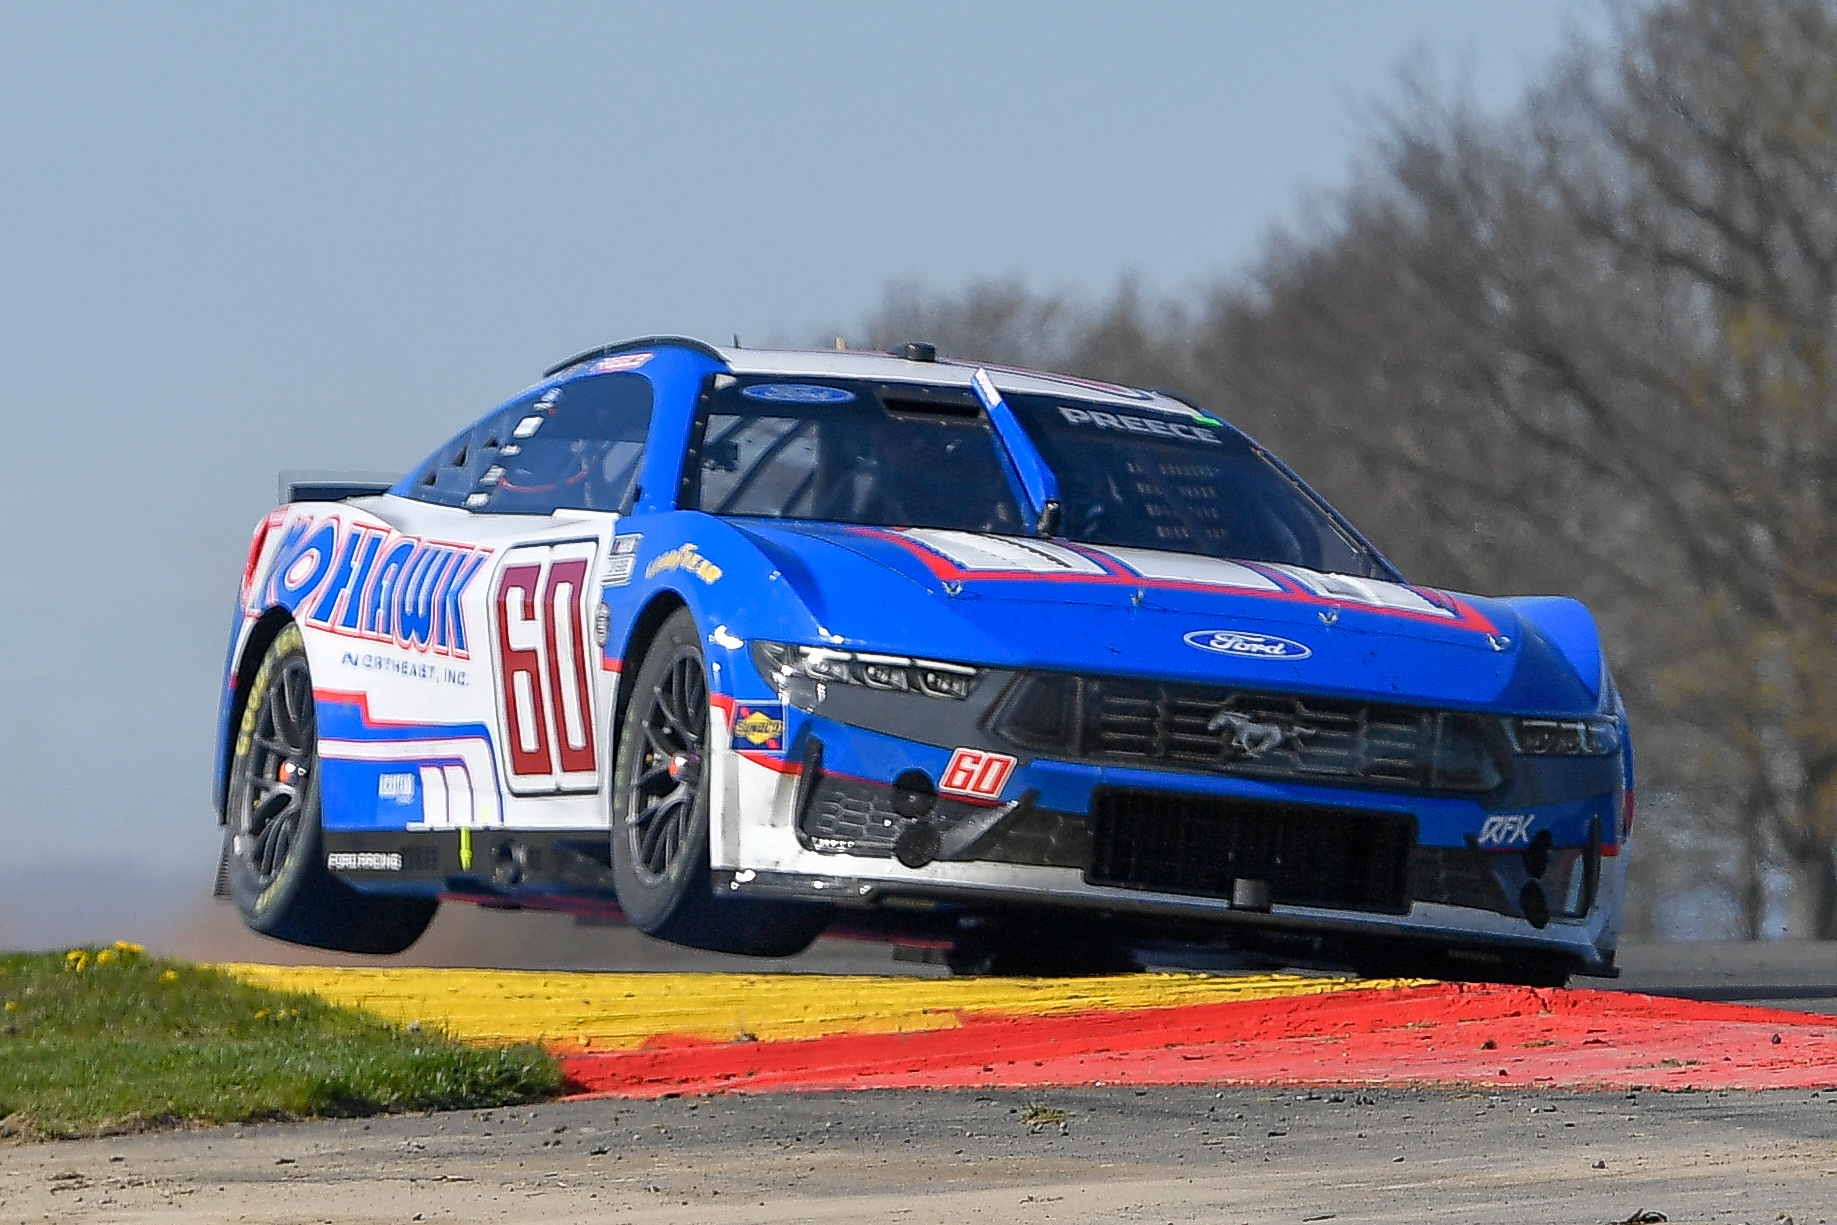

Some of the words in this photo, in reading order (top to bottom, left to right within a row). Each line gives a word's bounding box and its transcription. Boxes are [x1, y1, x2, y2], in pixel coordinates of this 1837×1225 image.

[1057, 405, 1223, 445] PREECE
[1209, 632, 1287, 655] Ford
[500, 557, 597, 777] 60
[942, 752, 1013, 796] 60
